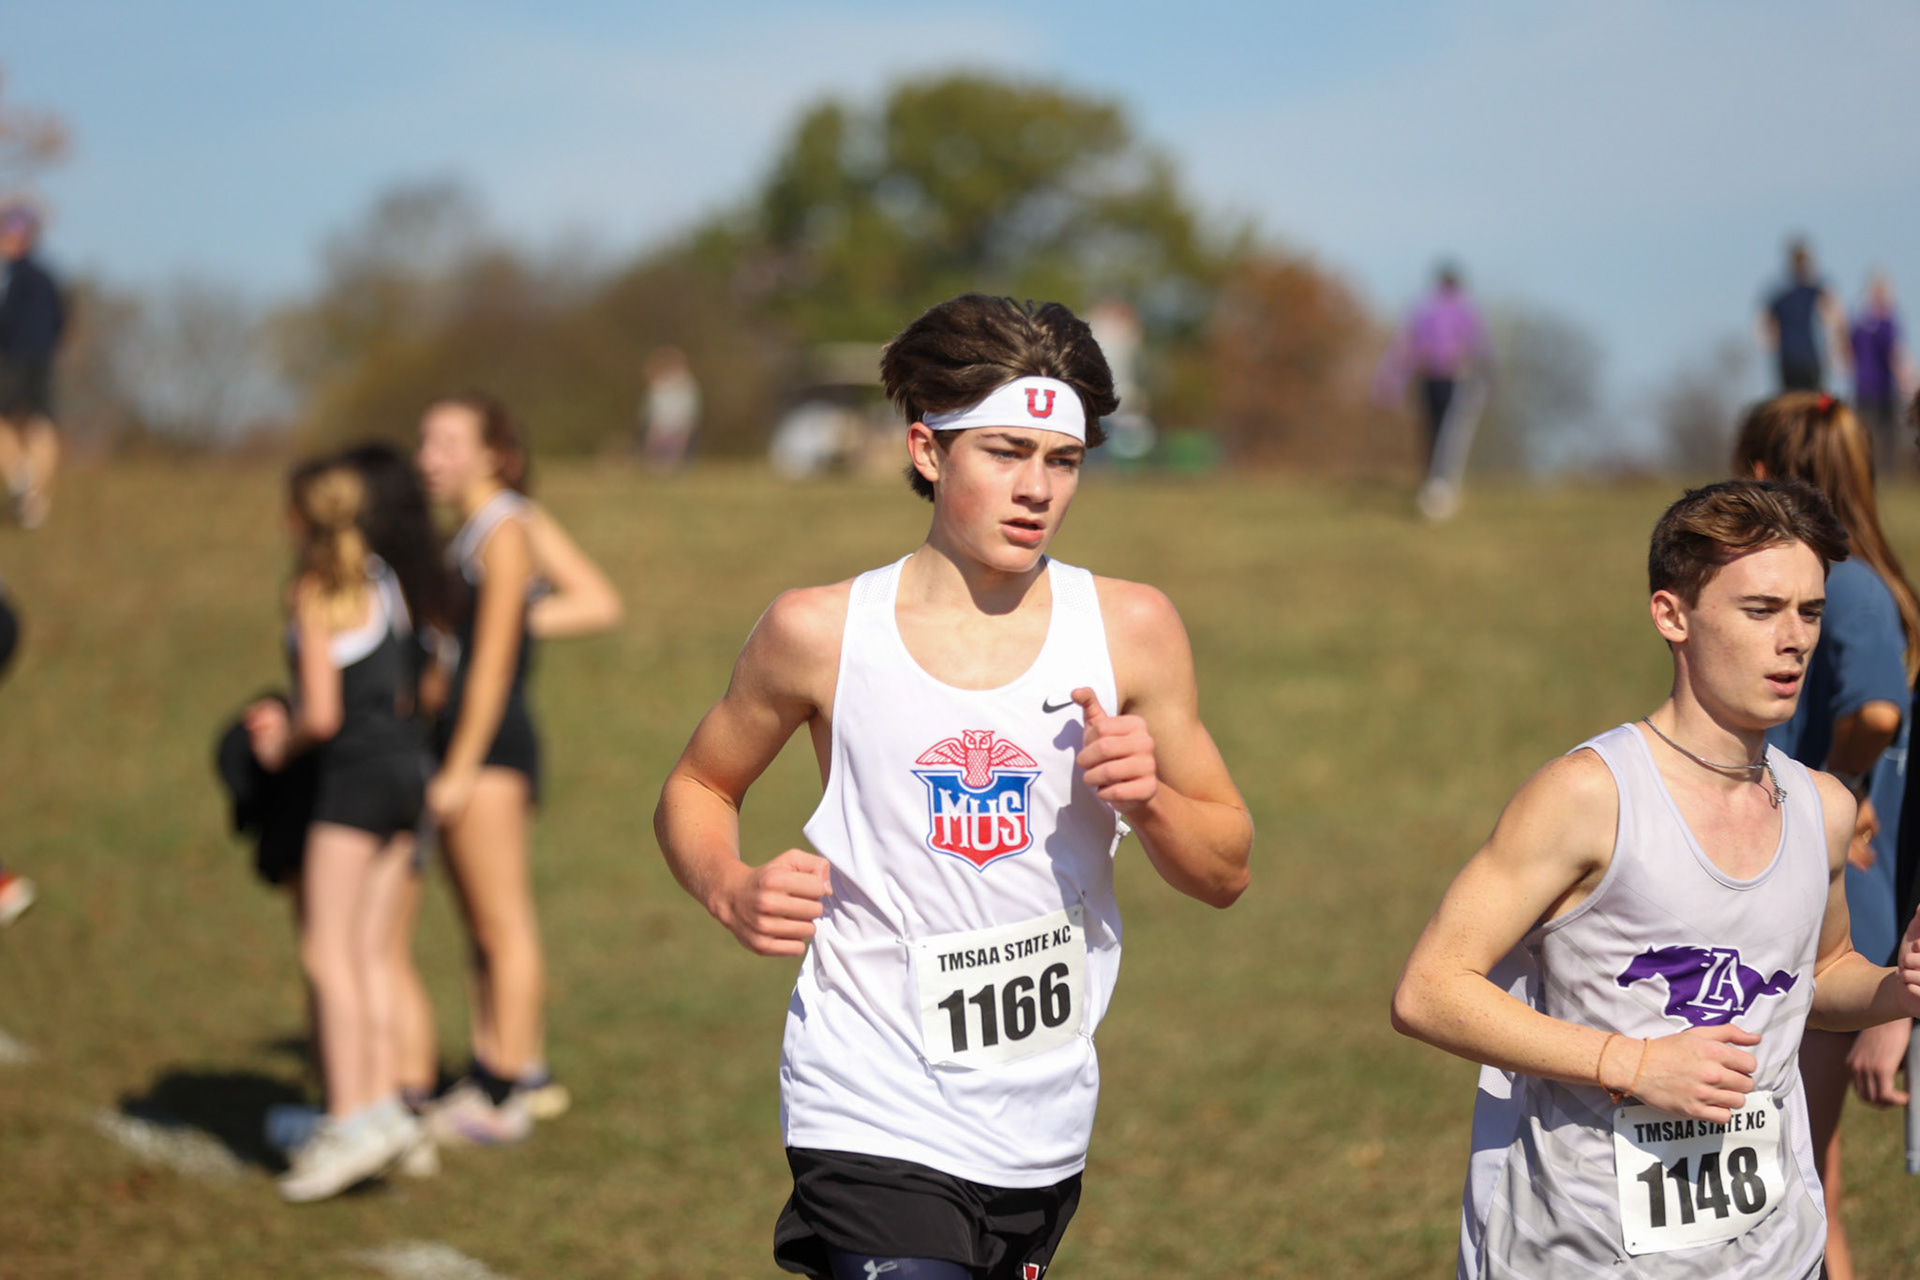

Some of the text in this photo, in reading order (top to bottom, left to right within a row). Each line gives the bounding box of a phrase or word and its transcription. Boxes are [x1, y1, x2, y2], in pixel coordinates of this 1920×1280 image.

[1024, 387, 1056, 419] U
[938, 787, 1022, 851] MUS
[937, 925, 1072, 973] TMSAA STATE XC
[937, 962, 1071, 1053] 1166
[1634, 1119, 1695, 1143] TMSAA
[1746, 1110, 1766, 1130] XC
[1636, 1146, 1767, 1228] 1148
